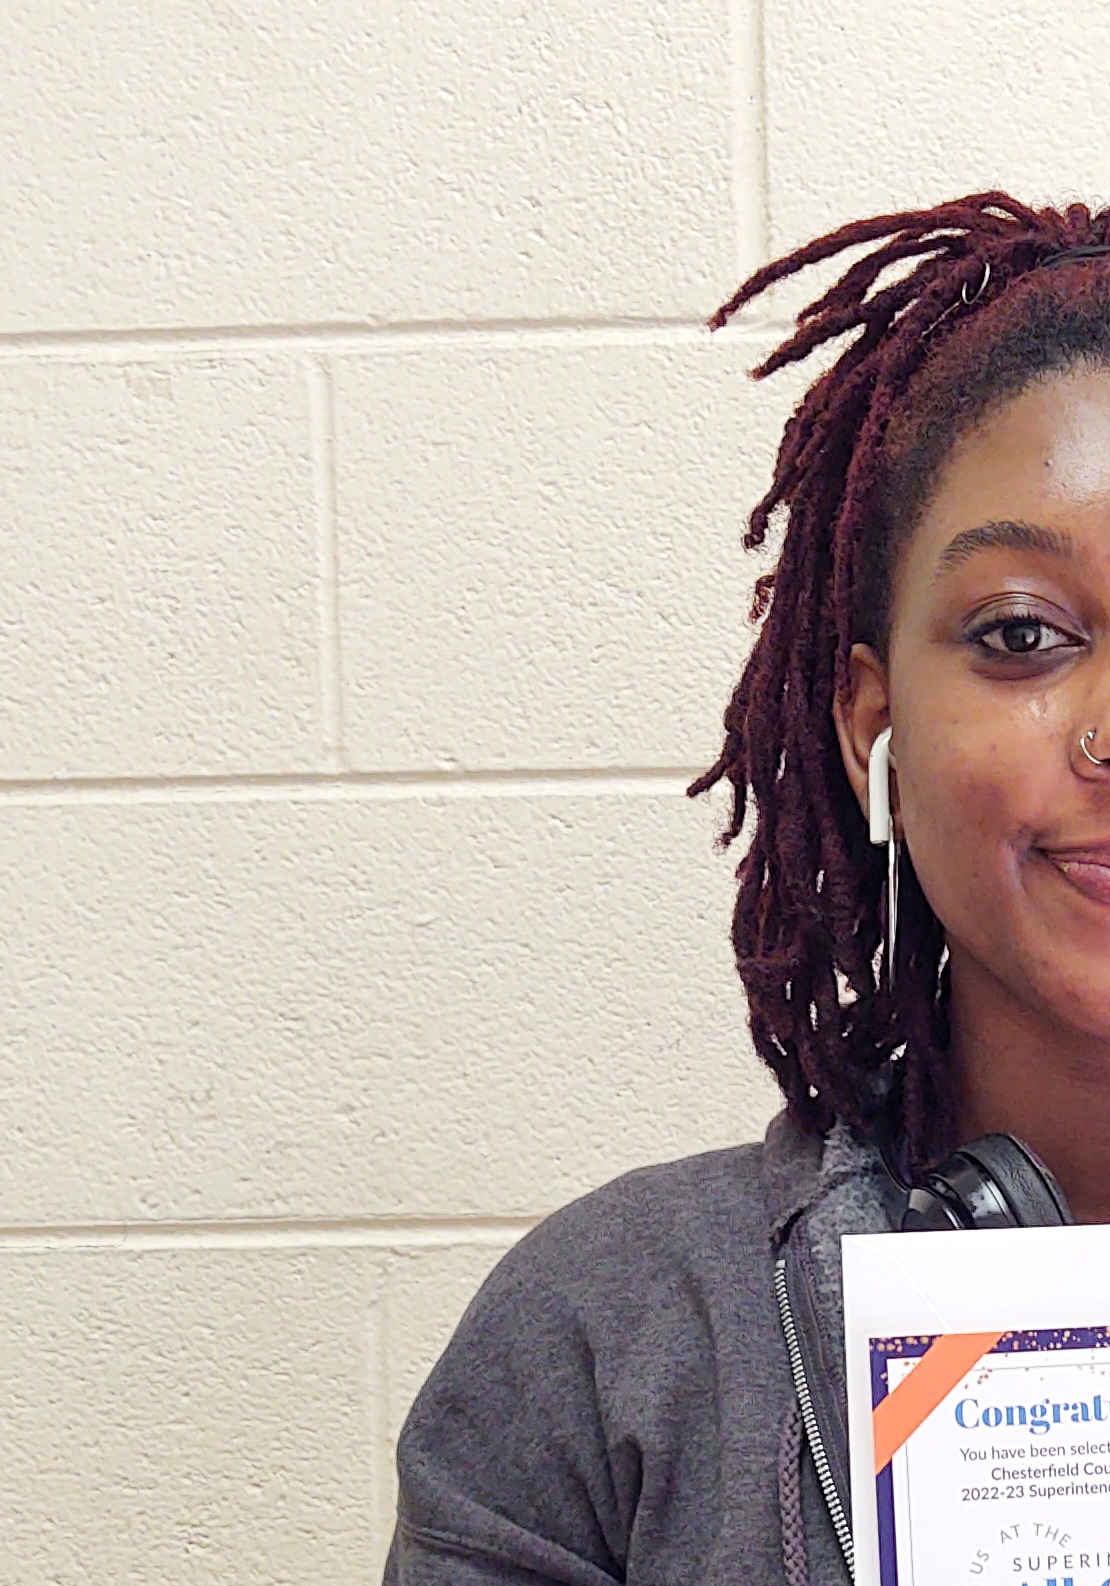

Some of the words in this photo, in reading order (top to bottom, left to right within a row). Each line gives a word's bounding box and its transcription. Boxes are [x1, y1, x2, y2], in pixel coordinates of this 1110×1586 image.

[960, 1447, 987, 1462] You
[991, 1446, 1026, 1460] have
[1030, 1444, 1066, 1458] been
[991, 1463, 1079, 1481] Chesterfield
[961, 1484, 1025, 1502] 2022-23
[969, 1549, 990, 1575] US
[1000, 1524, 1020, 1544] AT
[1032, 1522, 1072, 1548] THE
